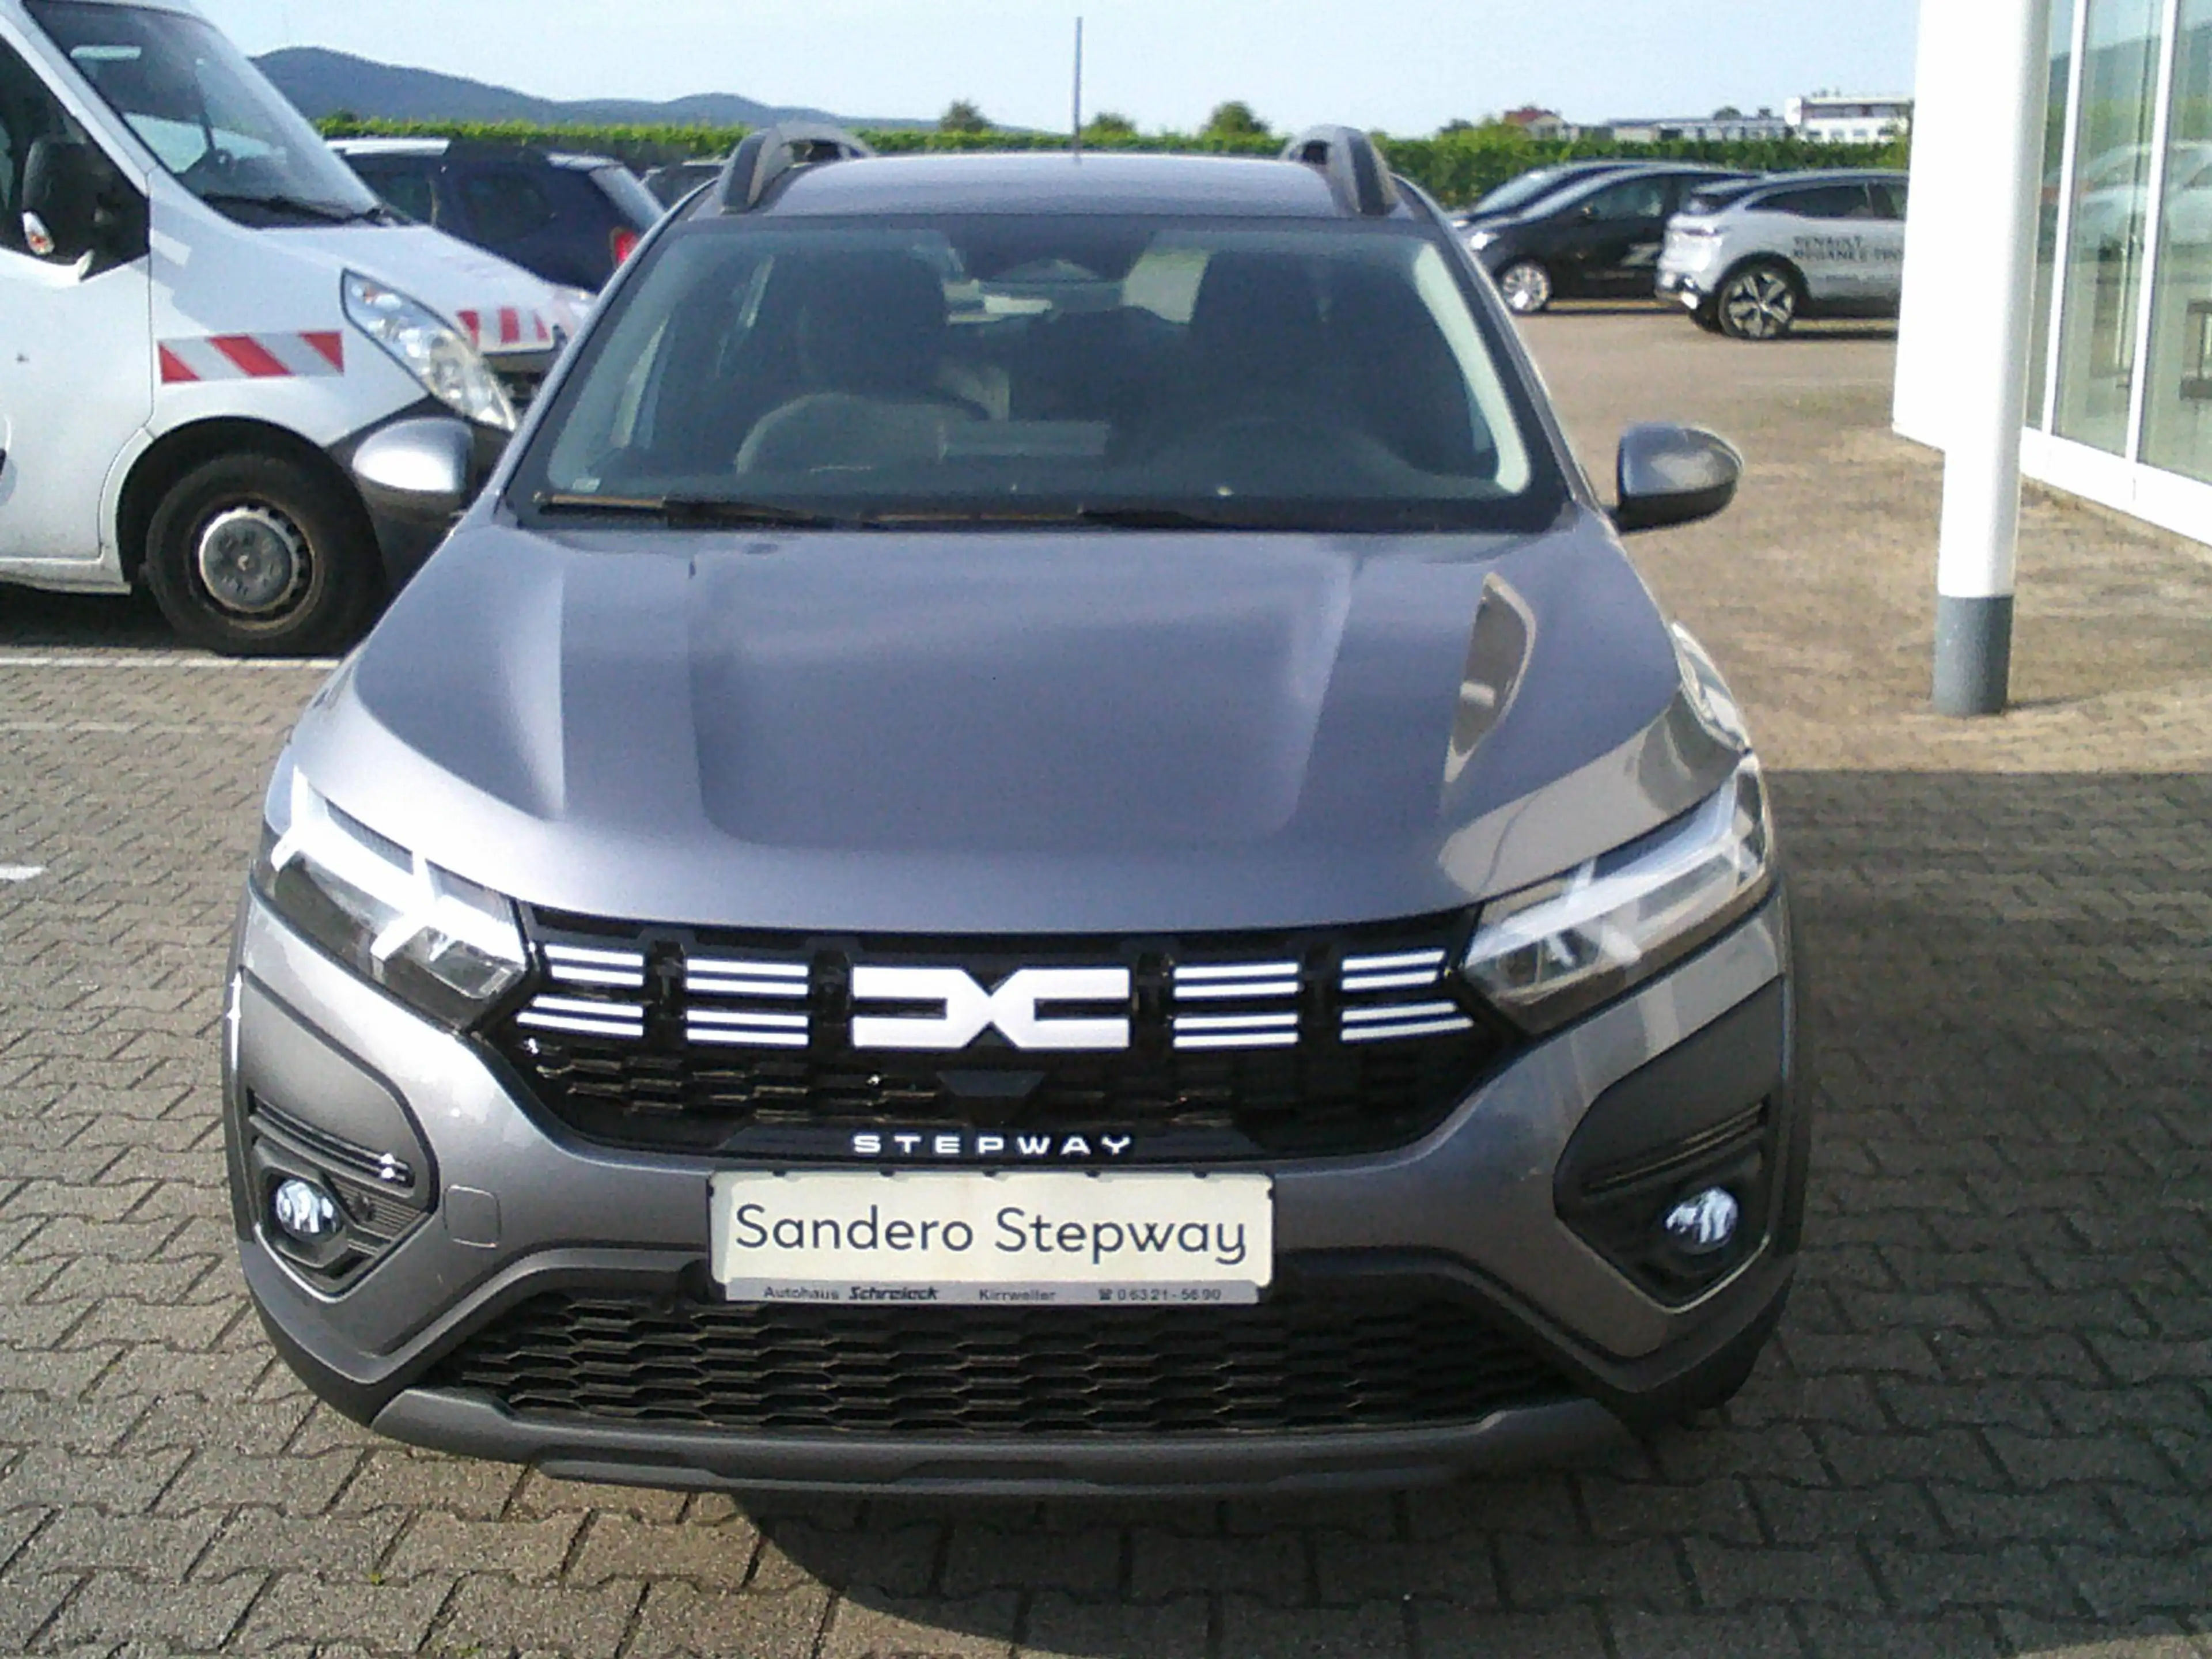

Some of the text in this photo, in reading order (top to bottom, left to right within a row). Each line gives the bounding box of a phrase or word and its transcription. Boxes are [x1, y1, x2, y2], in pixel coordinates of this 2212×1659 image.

[853, 1135, 1131, 1154] STEPWAY
[736, 1203, 1247, 1266] Sandero Stepway
[763, 1286, 840, 1300] Autohaus
